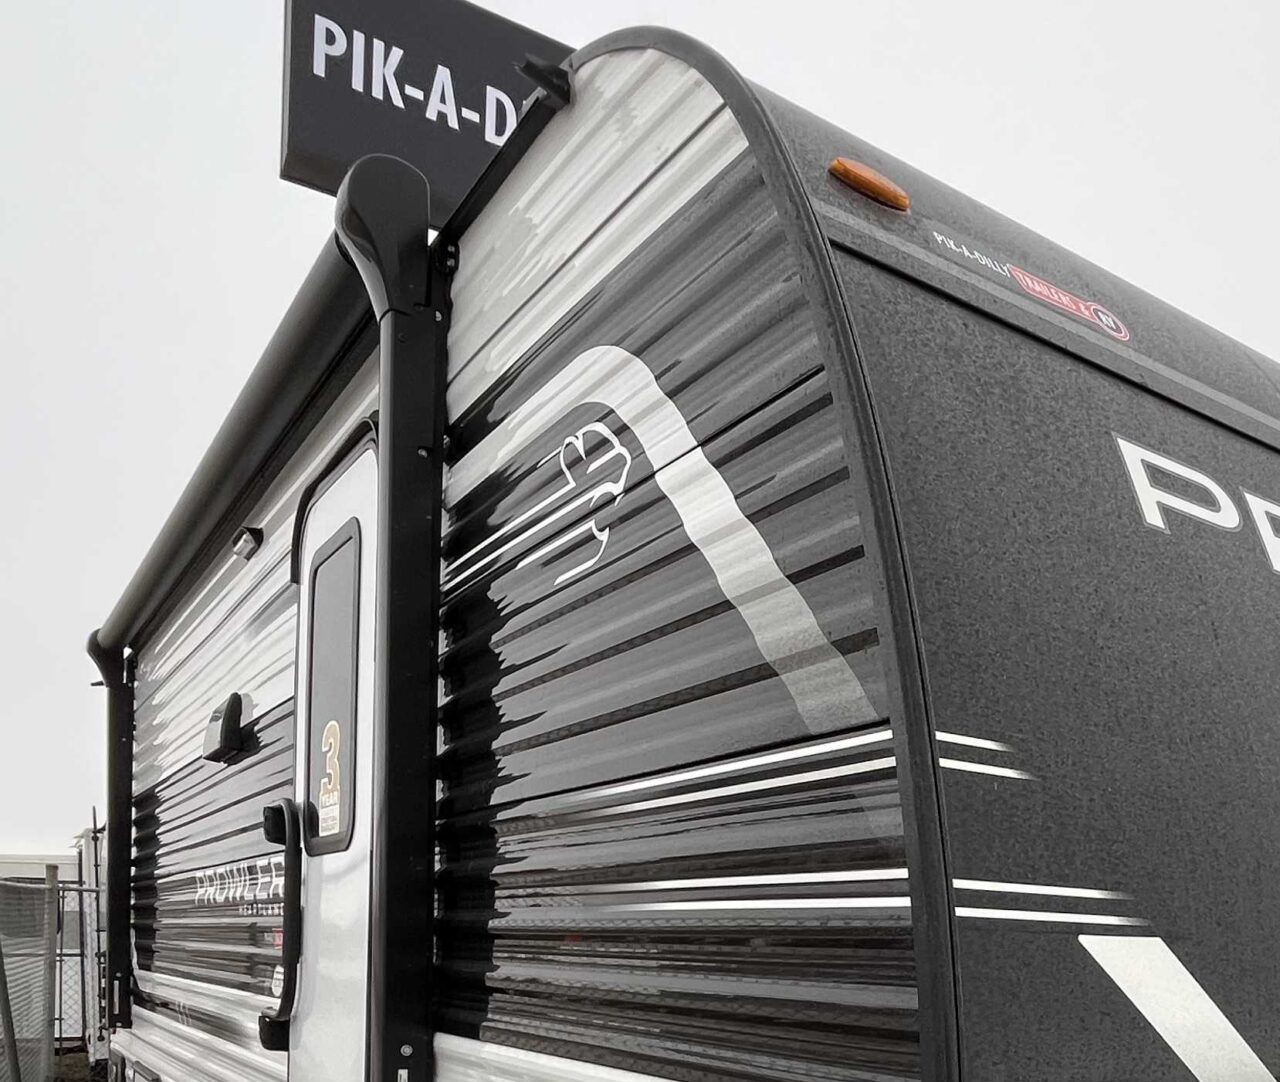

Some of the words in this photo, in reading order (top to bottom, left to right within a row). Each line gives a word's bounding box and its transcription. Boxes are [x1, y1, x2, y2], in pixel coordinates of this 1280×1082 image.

[933, 231, 1011, 278] PIK-A-DILLY
[1015, 270, 1076, 310] TRAILERS
[1097, 311, 1117, 330] RV
[321, 720, 340, 793] 3
